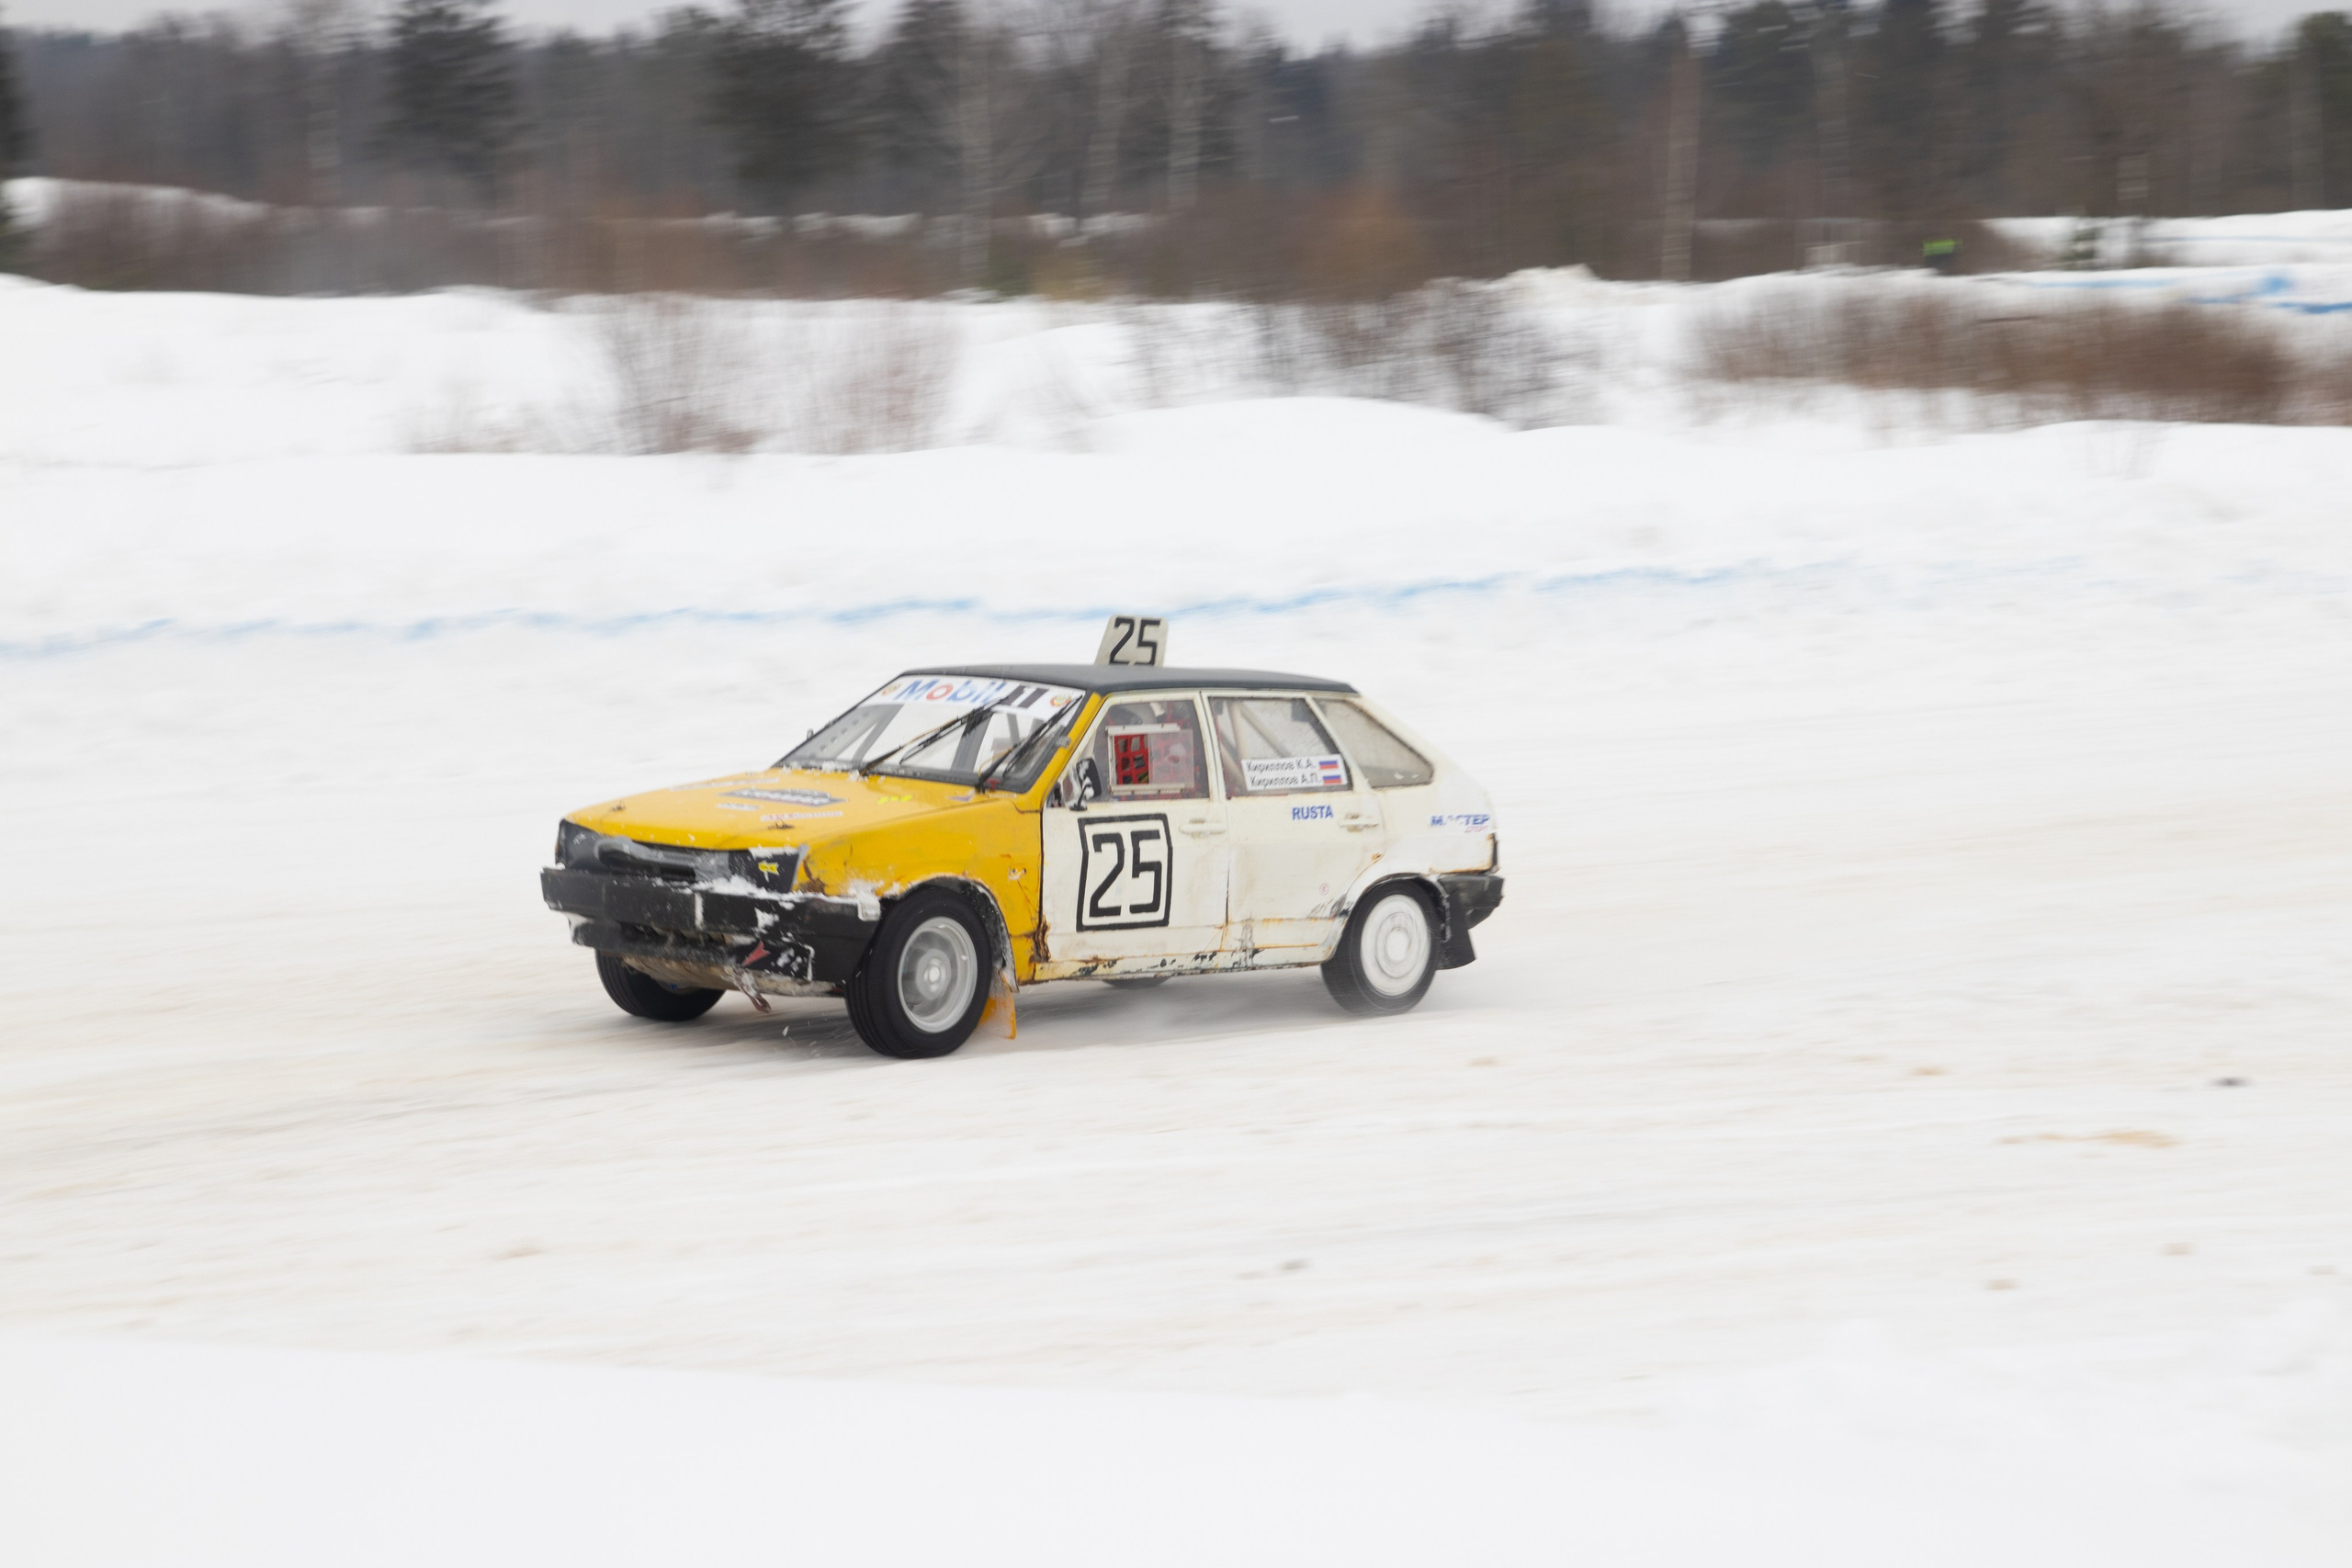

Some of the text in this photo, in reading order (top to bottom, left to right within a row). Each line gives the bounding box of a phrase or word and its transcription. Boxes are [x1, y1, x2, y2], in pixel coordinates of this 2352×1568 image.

[1109, 616, 1161, 665] 25
[893, 679, 1007, 705] Mobil
[1246, 760, 1295, 774] Кириллов
[1250, 775, 1299, 789] Кириллов
[1292, 805, 1334, 820] RUSTA
[1430, 814, 1491, 827] МТЕР
[1089, 829, 1163, 918] 25
